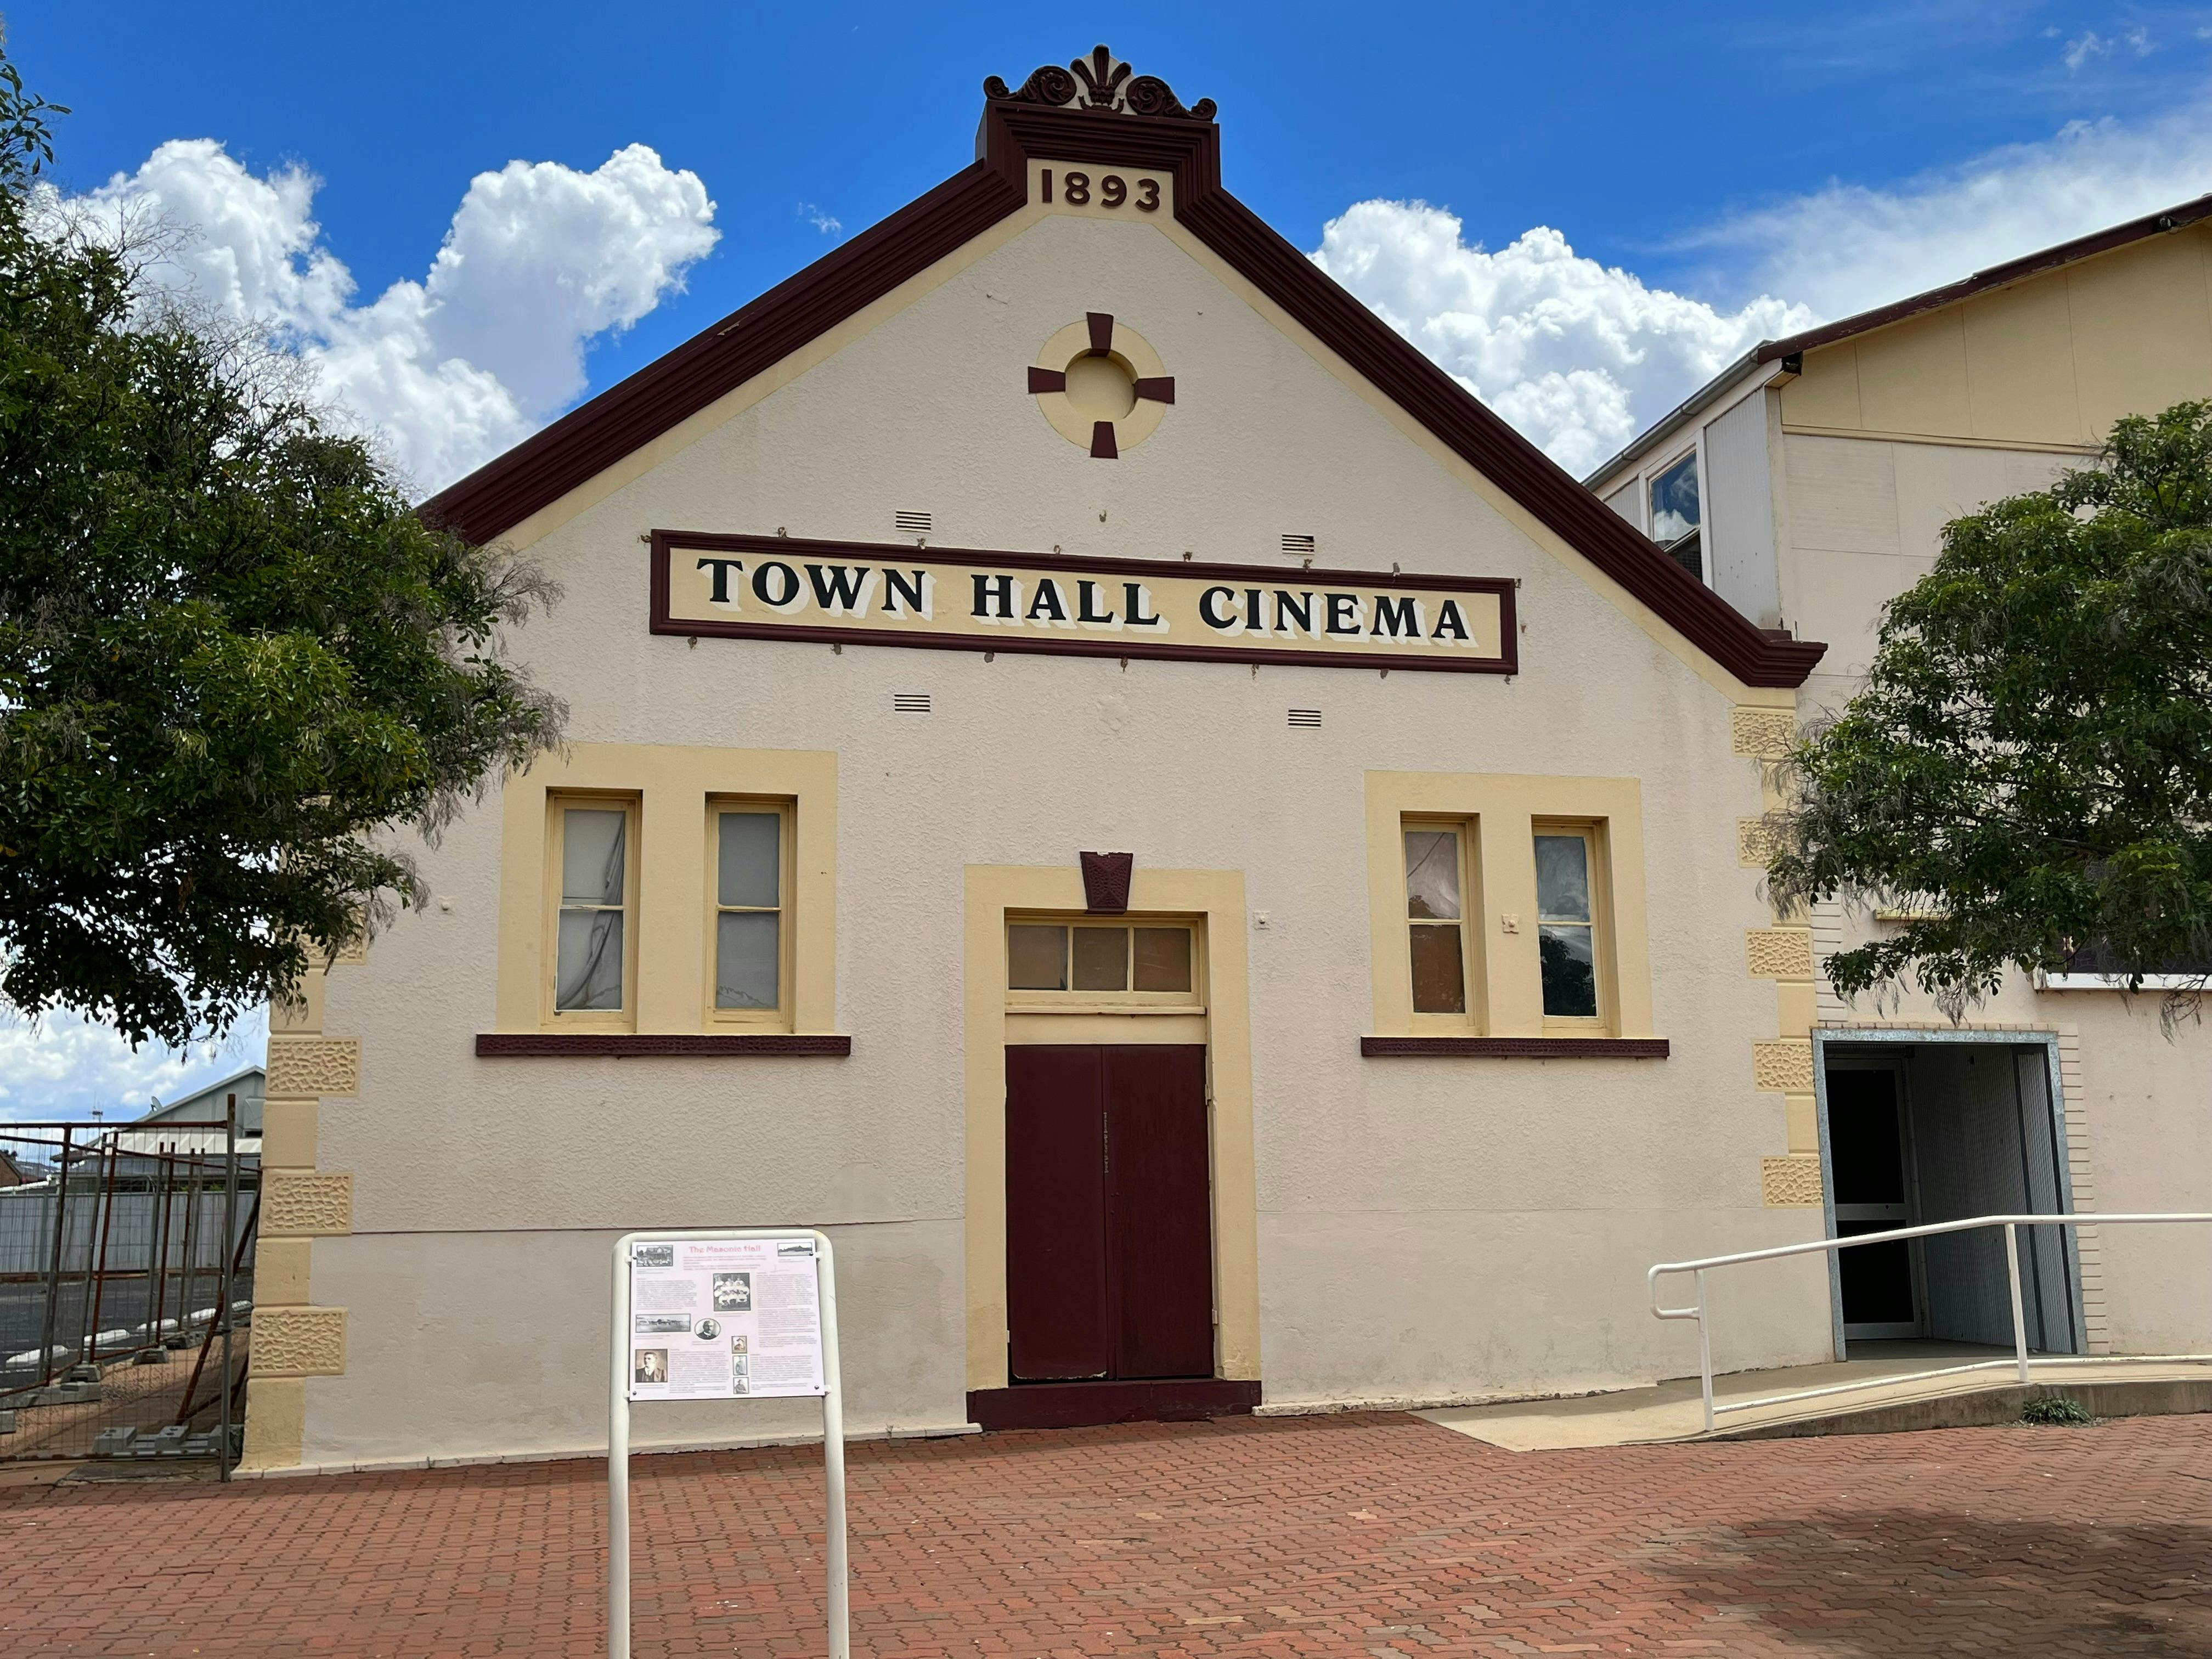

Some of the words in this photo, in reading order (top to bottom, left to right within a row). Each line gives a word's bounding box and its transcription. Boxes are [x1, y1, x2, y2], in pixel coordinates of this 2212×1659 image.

[1042, 168, 1160, 212] 1893
[696, 558, 929, 615] TOWN
[970, 574, 1164, 628] HALL
[1199, 586, 1472, 643] CINEMA
